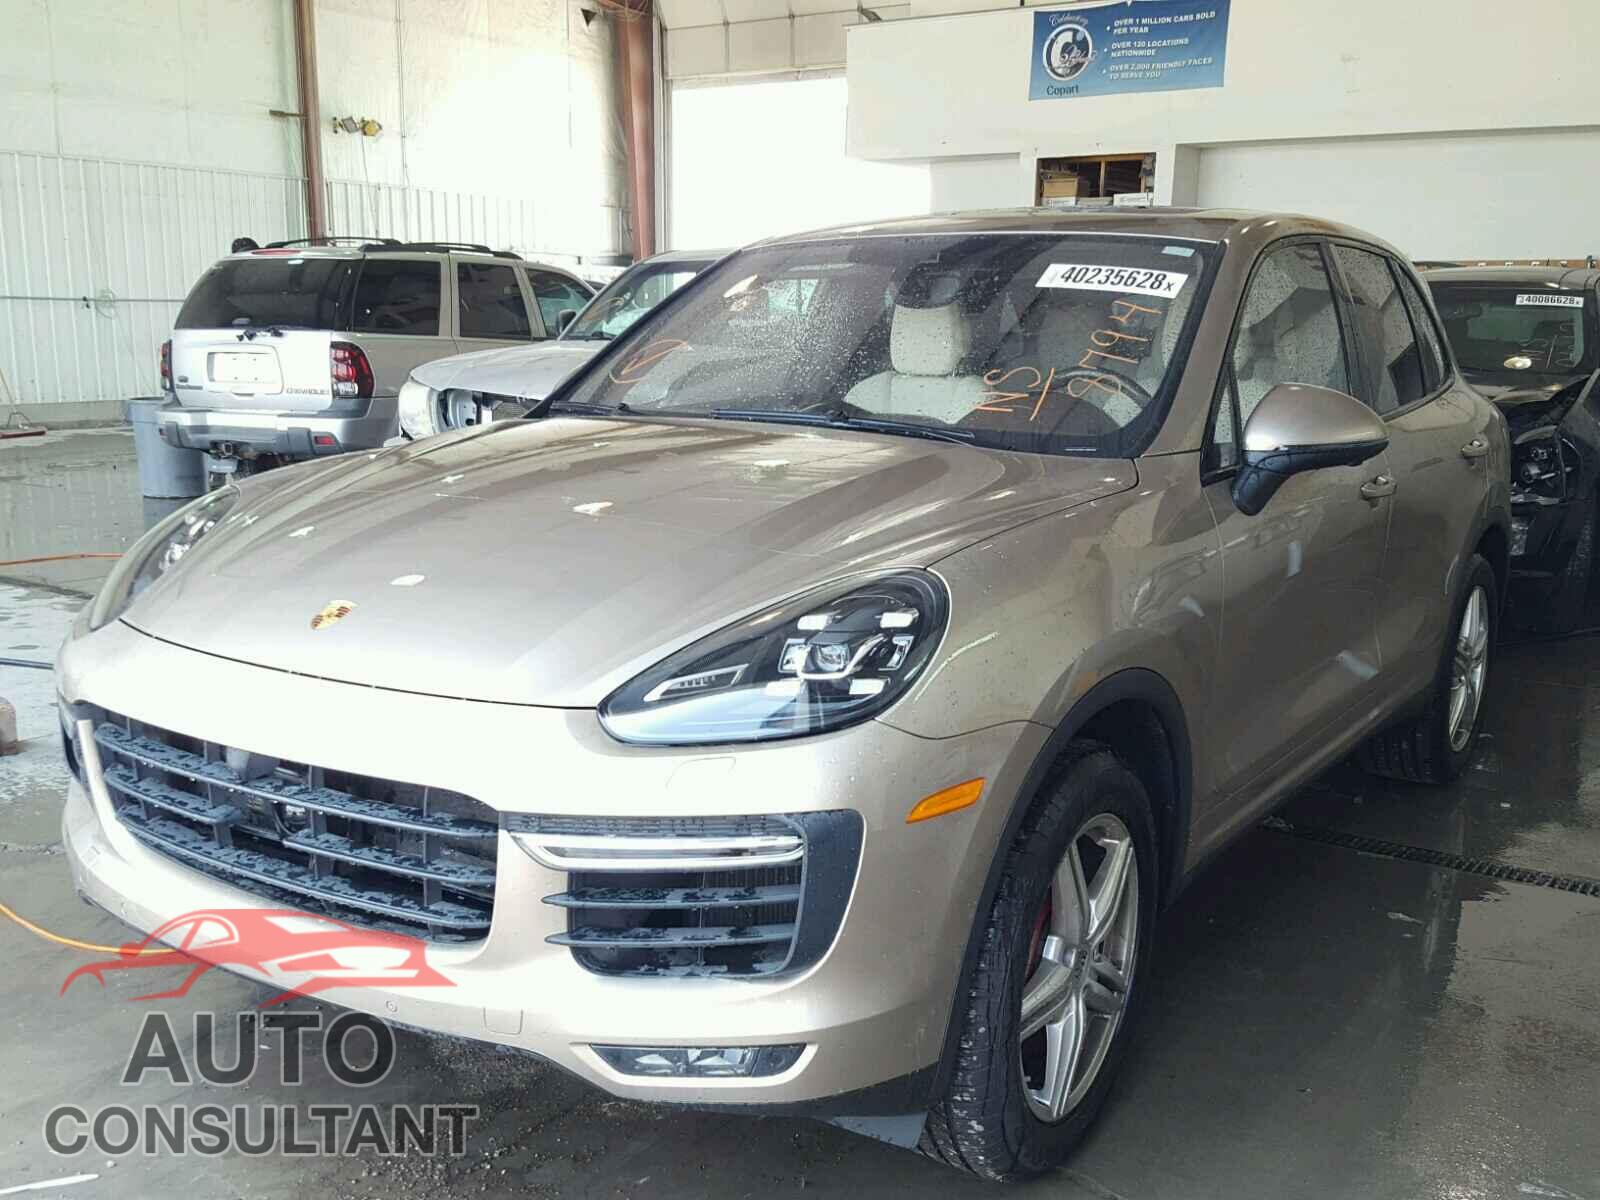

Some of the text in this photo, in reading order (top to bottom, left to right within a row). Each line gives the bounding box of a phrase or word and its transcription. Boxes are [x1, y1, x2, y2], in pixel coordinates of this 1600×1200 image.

[1114, 19, 1134, 27] OVER
[1141, 17, 1172, 25] MILLION
[1173, 13, 1194, 23] CARS
[1195, 11, 1216, 20] SOLD
[1111, 41, 1132, 49] OVER
[1147, 38, 1189, 47] LOCATIONS
[1111, 49, 1157, 57] NATIONWIDE
[1046, 84, 1079, 96] Copart
